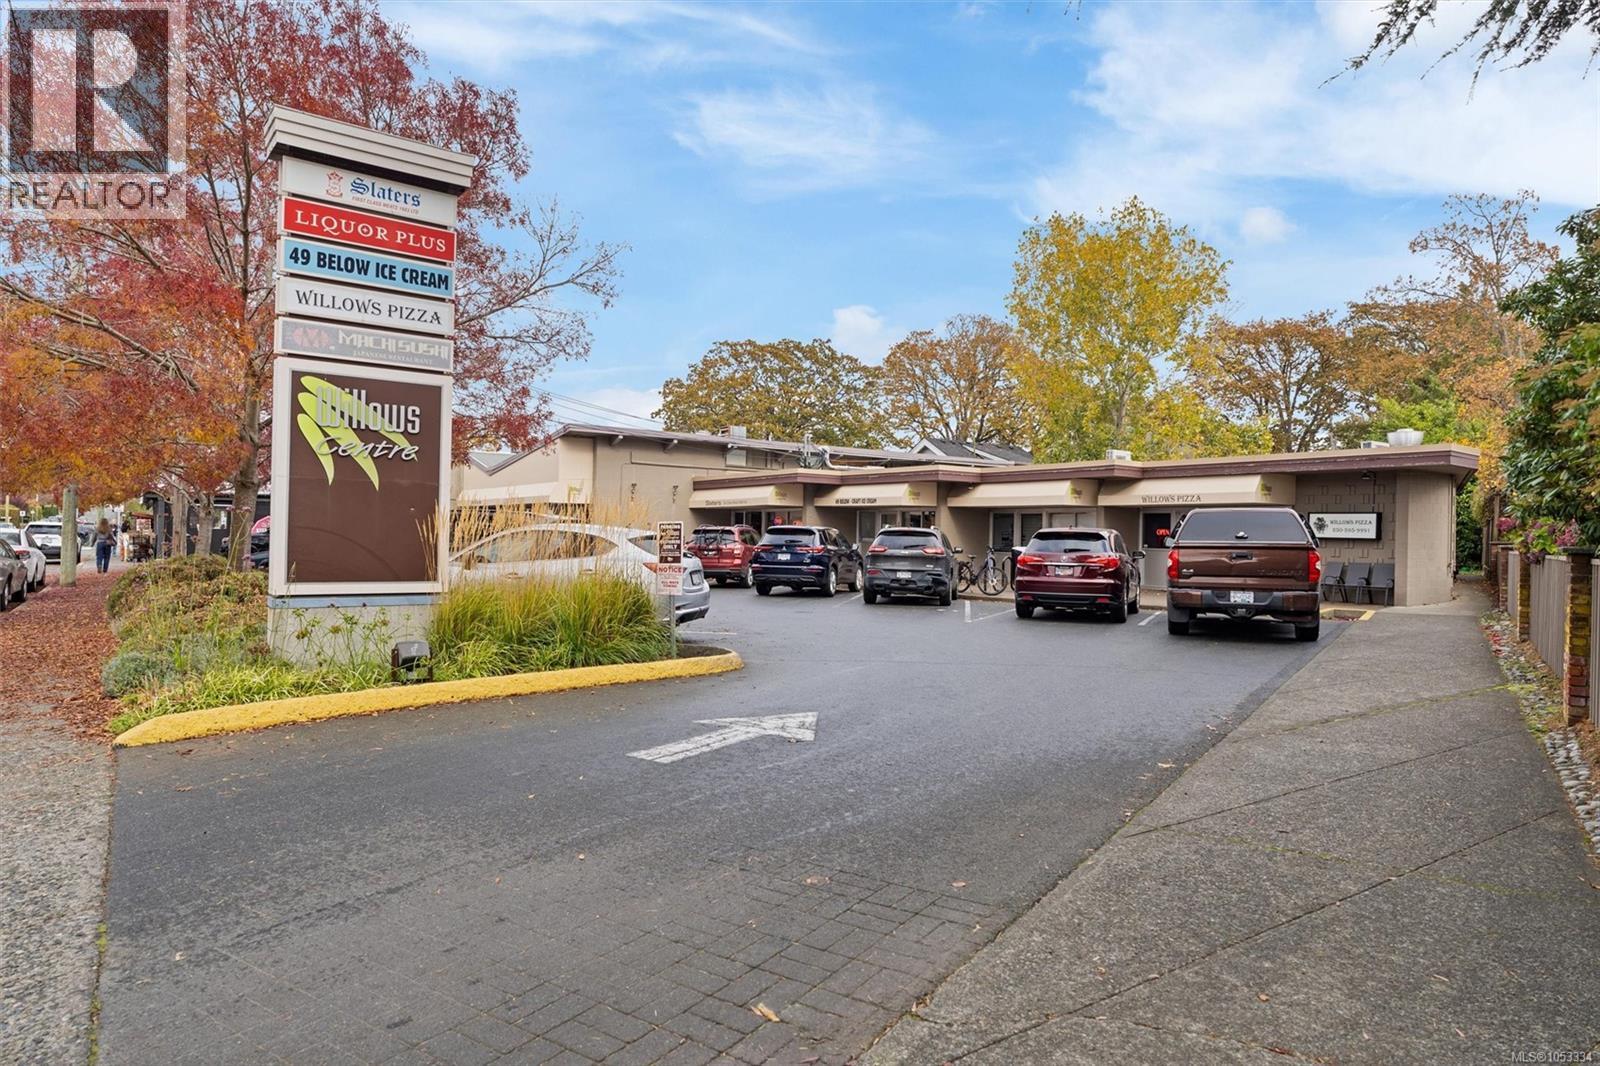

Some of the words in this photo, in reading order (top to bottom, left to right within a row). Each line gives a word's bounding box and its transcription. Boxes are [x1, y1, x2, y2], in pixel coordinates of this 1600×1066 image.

[350, 177, 421, 207] Slaters
[295, 210, 389, 241] LIQUOR
[395, 230, 446, 252] PLUS
[289, 247, 311, 266] 49
[317, 251, 370, 276] BELOW
[375, 261, 396, 281] ICE
[401, 267, 449, 291] CREAM
[388, 304, 443, 326] PIZZA
[316, 385, 421, 435] Willows
[316, 436, 420, 461] Centre
